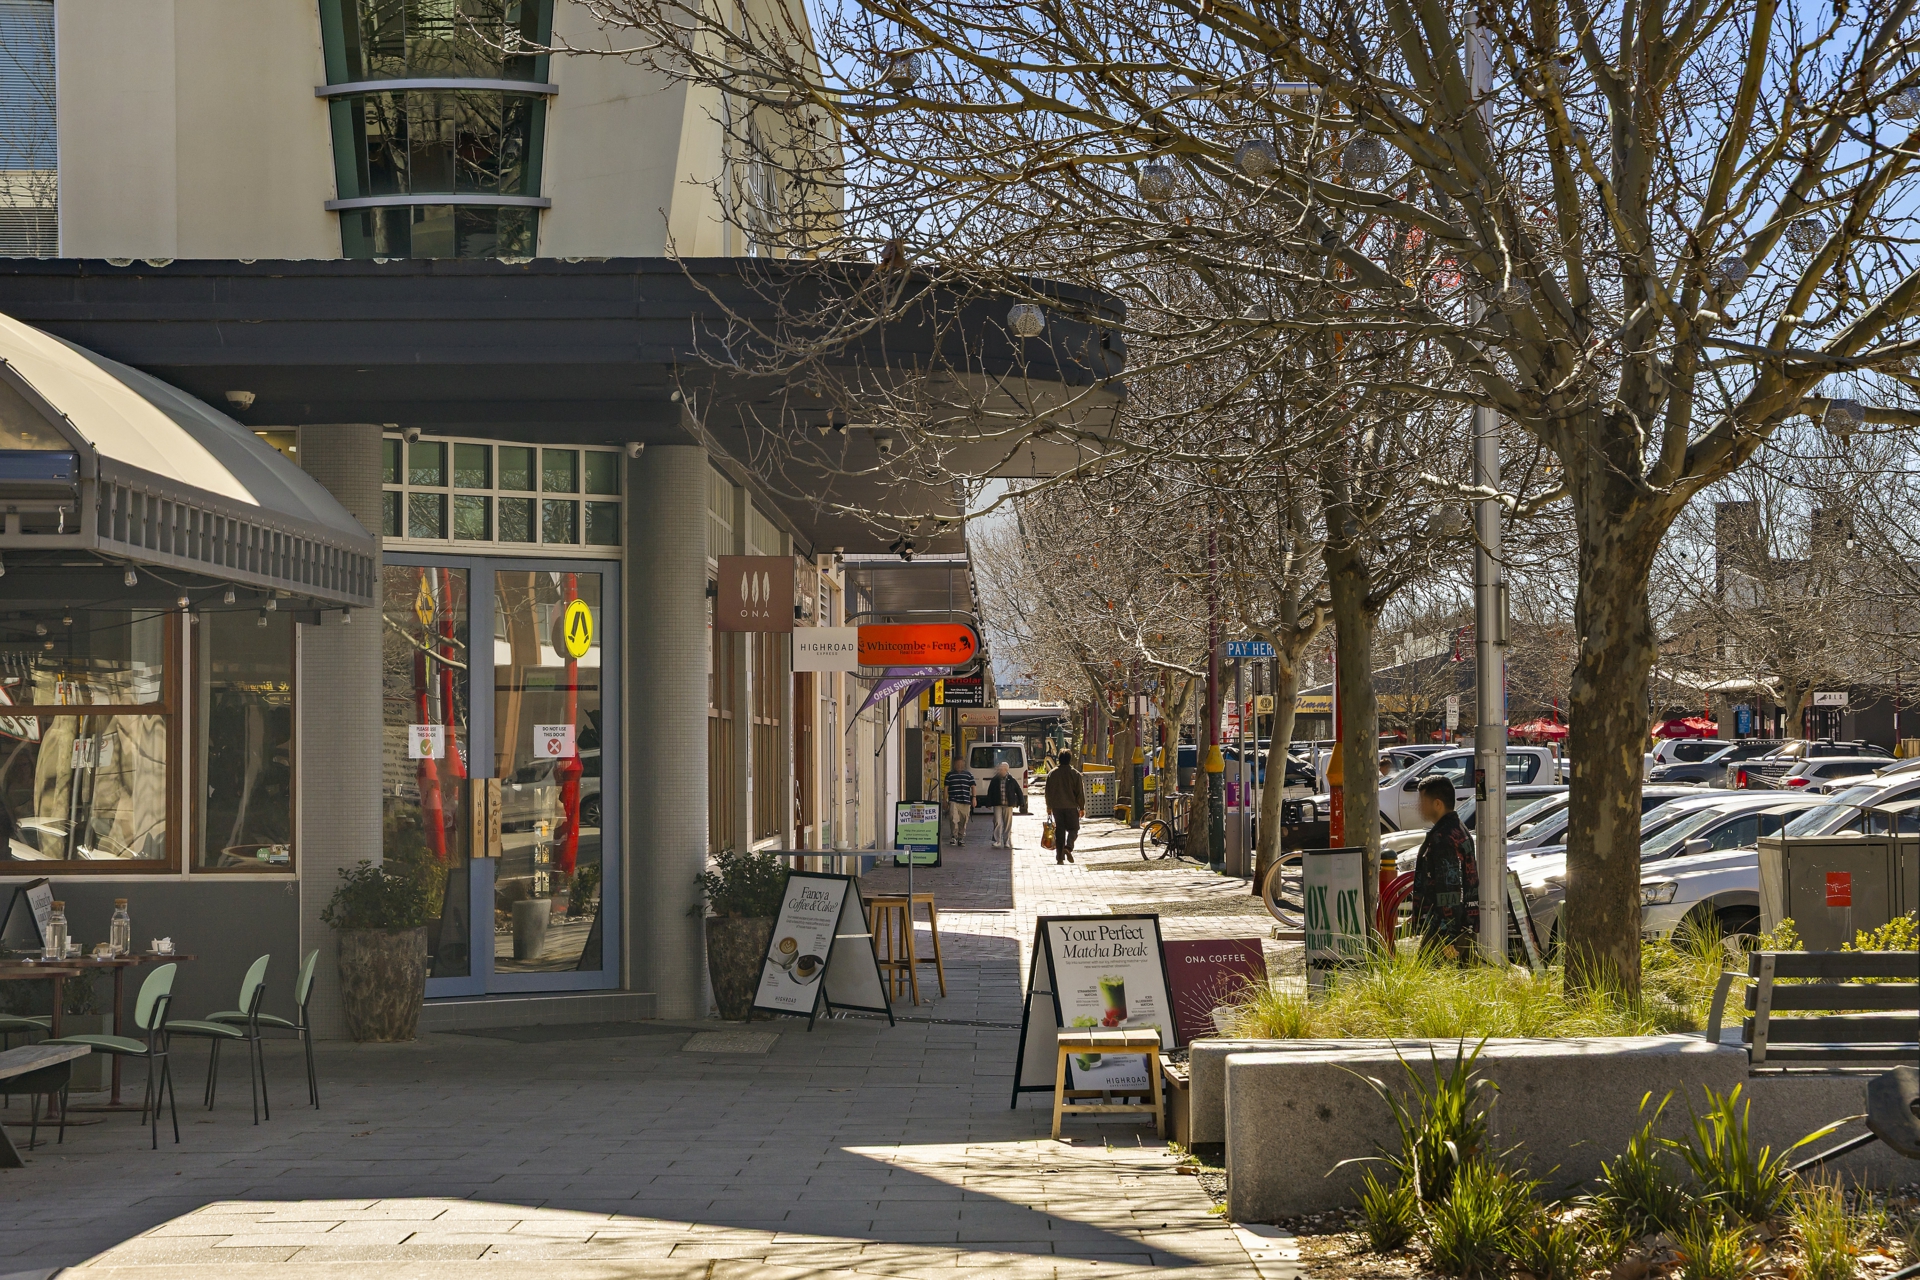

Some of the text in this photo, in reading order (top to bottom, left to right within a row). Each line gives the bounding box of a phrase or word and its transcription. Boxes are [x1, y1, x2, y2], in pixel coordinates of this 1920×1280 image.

[740, 609, 769, 618] ONA
[800, 643, 854, 652] HIGHROAD
[867, 641, 926, 651] Whitcombe
[932, 642, 956, 652] Feng
[1228, 643, 1247, 656] PAY
[874, 686, 894, 700] OPEN
[801, 887, 830, 902] Fancy a
[788, 898, 838, 912] Coffee & Cake?
[1307, 885, 1361, 934] OX OX
[1059, 924, 1144, 941] Your Perfect
[1062, 942, 1148, 958] Matcha Break
[1209, 954, 1246, 963] COFFEE
[1106, 1076, 1146, 1084] HIGHROAD
